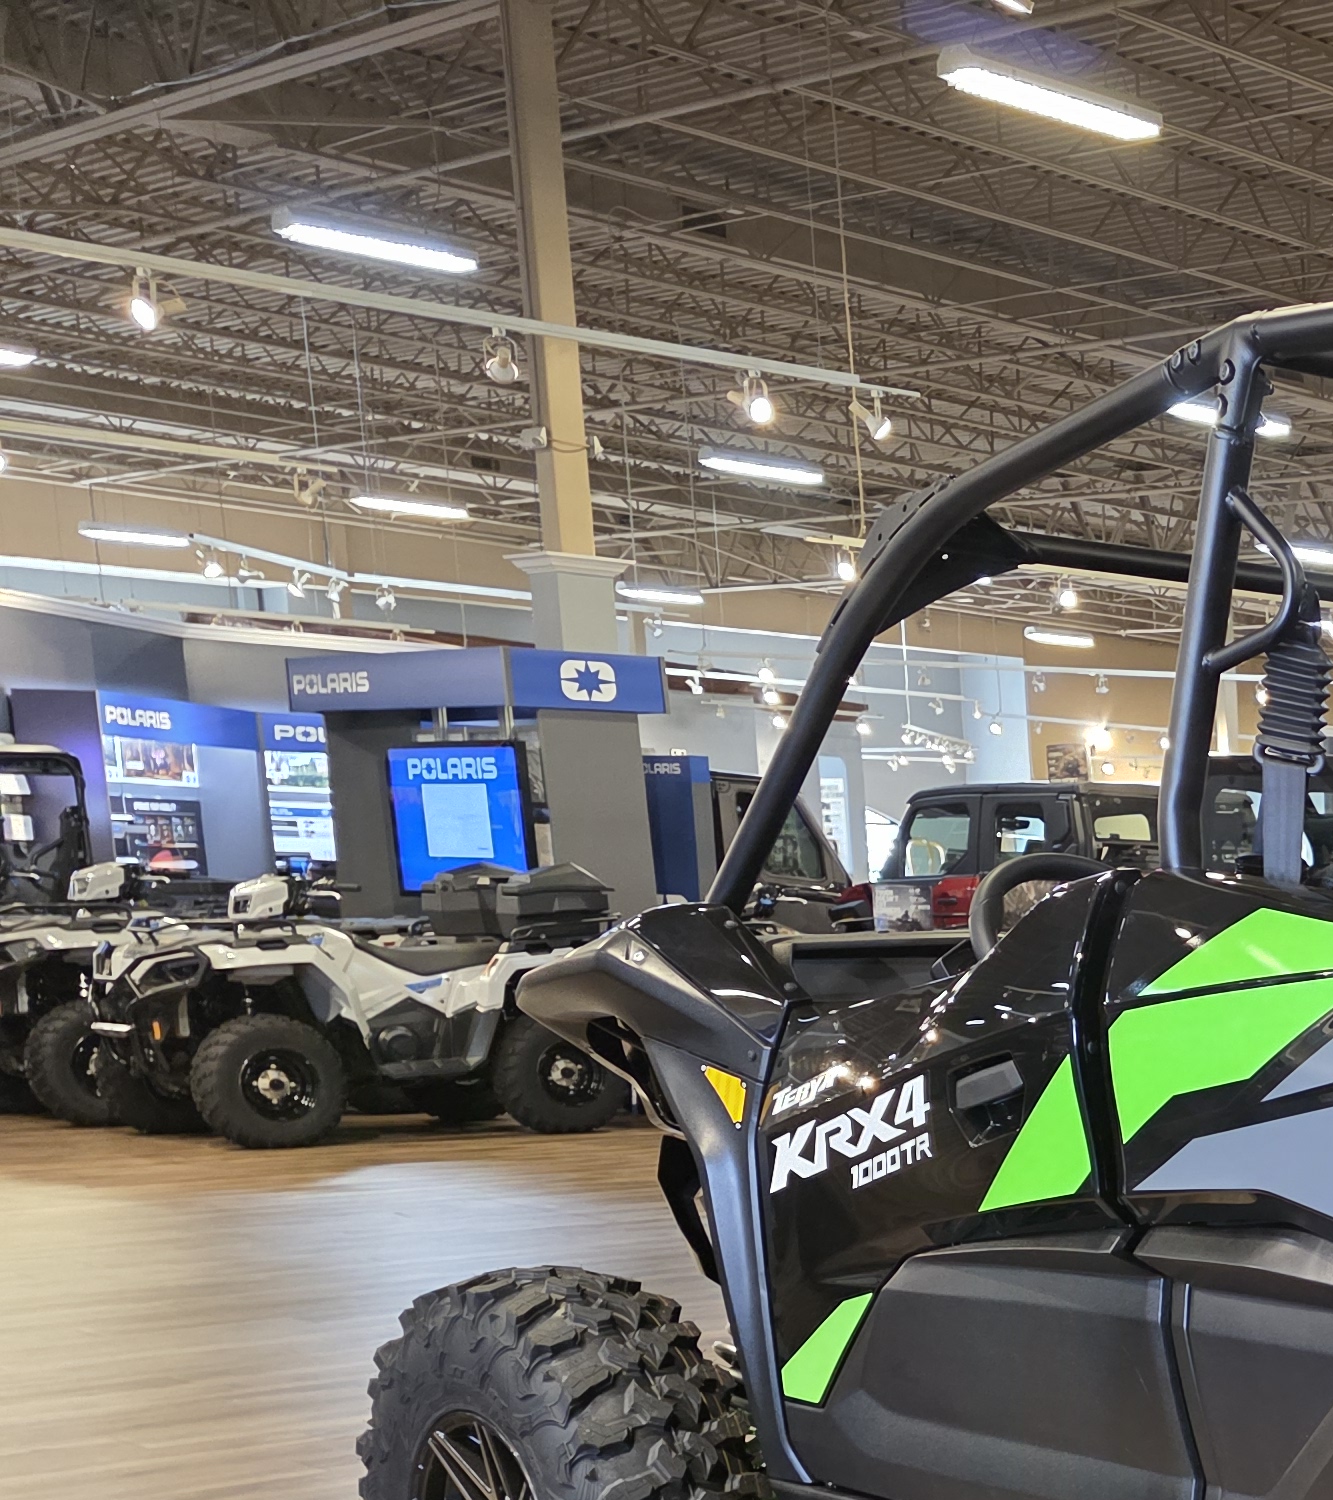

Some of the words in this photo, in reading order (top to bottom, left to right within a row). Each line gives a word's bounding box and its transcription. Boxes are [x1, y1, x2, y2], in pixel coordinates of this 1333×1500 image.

[293, 671, 370, 695] POLARIS
[104, 704, 172, 730] POLARIS
[407, 757, 498, 780] POLARIS
[769, 1073, 931, 1195] KRX4
[851, 1132, 933, 1190] 1000TR
